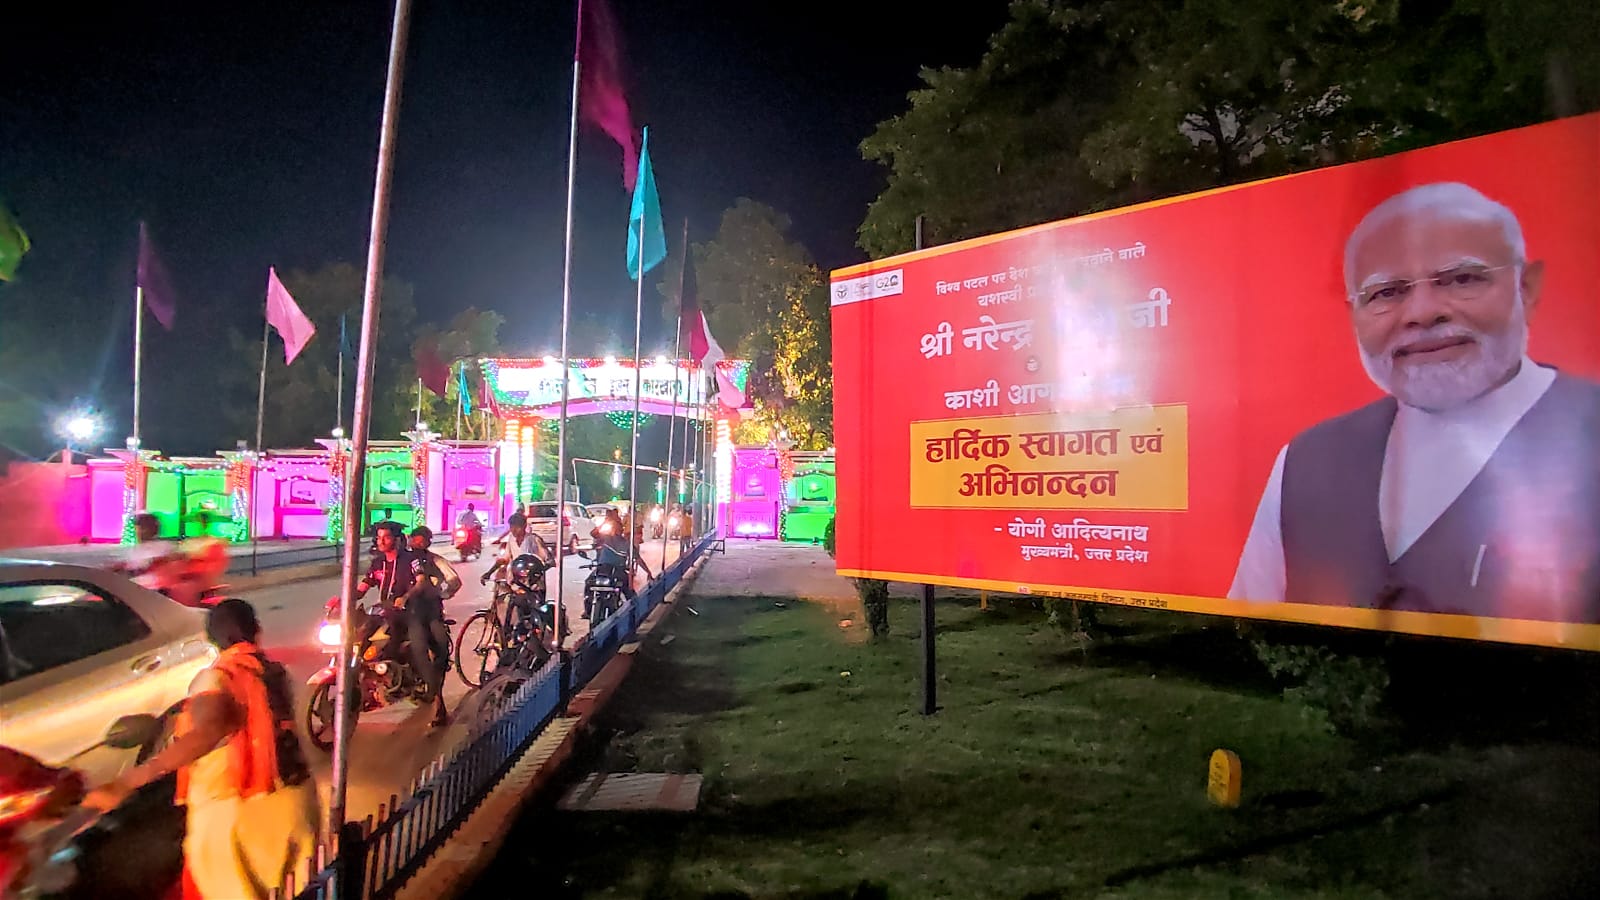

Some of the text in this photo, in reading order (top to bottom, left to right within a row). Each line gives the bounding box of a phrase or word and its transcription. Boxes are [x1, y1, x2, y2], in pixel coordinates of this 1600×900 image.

[936, 281, 961, 295] विश्व
[964, 275, 989, 290] पटल
[992, 272, 1006, 284] पर
[1008, 267, 1028, 281] देश
[1118, 241, 1146, 260] वाले
[977, 285, 1023, 307] यशस्वी
[920, 322, 955, 359] श्री
[962, 315, 1034, 351] नरेन्द्र
[1128, 287, 1171, 328] जी
[944, 380, 1000, 409] काशी
[925, 428, 1164, 463] हार्दिक स्वागत एवं
[958, 463, 1119, 498] अभिनन्दन
[1008, 517, 1046, 538] योगी
[1051, 518, 1148, 541] आदित्यनाथ
[1021, 542, 1148, 563] मुख्यमंत्री, उत्तर प्रदेश
